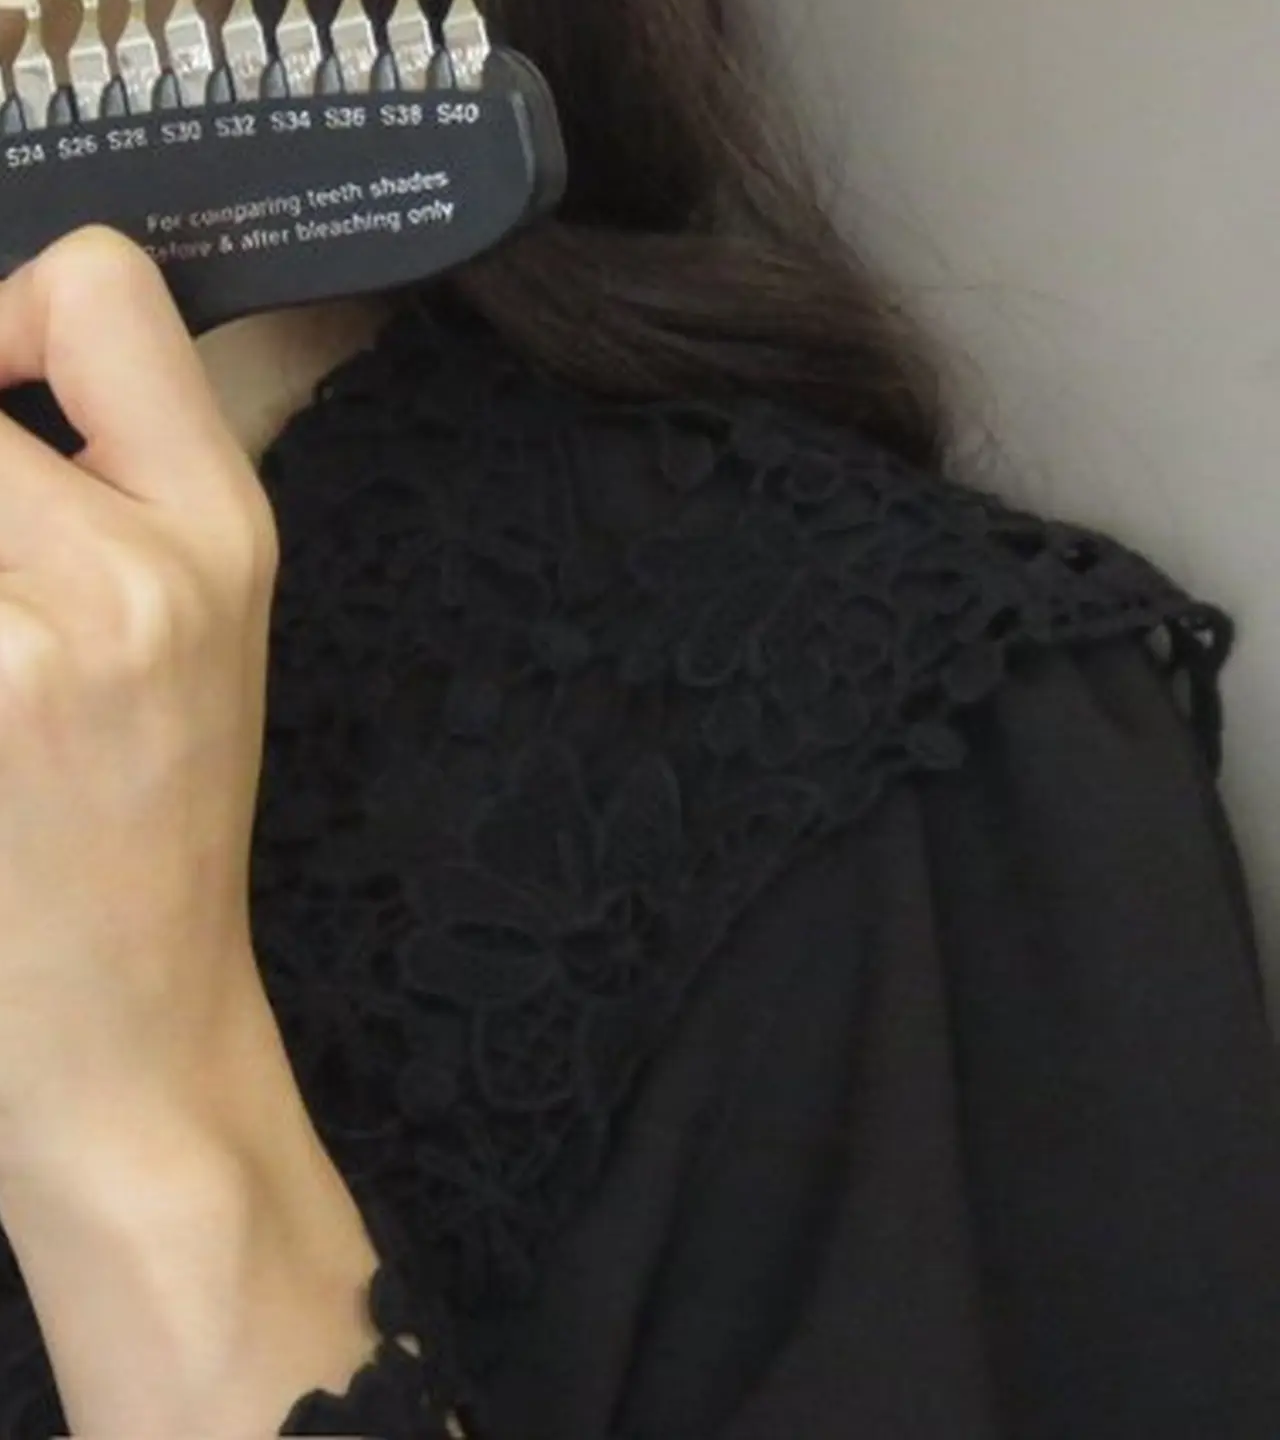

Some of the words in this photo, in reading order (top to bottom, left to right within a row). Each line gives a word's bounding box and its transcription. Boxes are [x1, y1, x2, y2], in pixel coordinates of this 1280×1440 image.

[6, 143, 45, 168] S24
[59, 134, 98, 157] S26
[107, 127, 148, 151] S28
[161, 120, 201, 143] S30
[215, 115, 255, 137] S32
[271, 110, 311, 133] S34
[325, 106, 365, 129] S36
[380, 104, 422, 126] S38
[436, 103, 479, 124] S40
[148, 212, 182, 232] For
[189, 192, 301, 232] comparing
[307, 184, 364, 207] teeth
[369, 170, 449, 196] shades
[219, 232, 233, 253] &
[240, 223, 290, 250] after
[297, 209, 400, 243] bleaching
[406, 201, 456, 228] only
